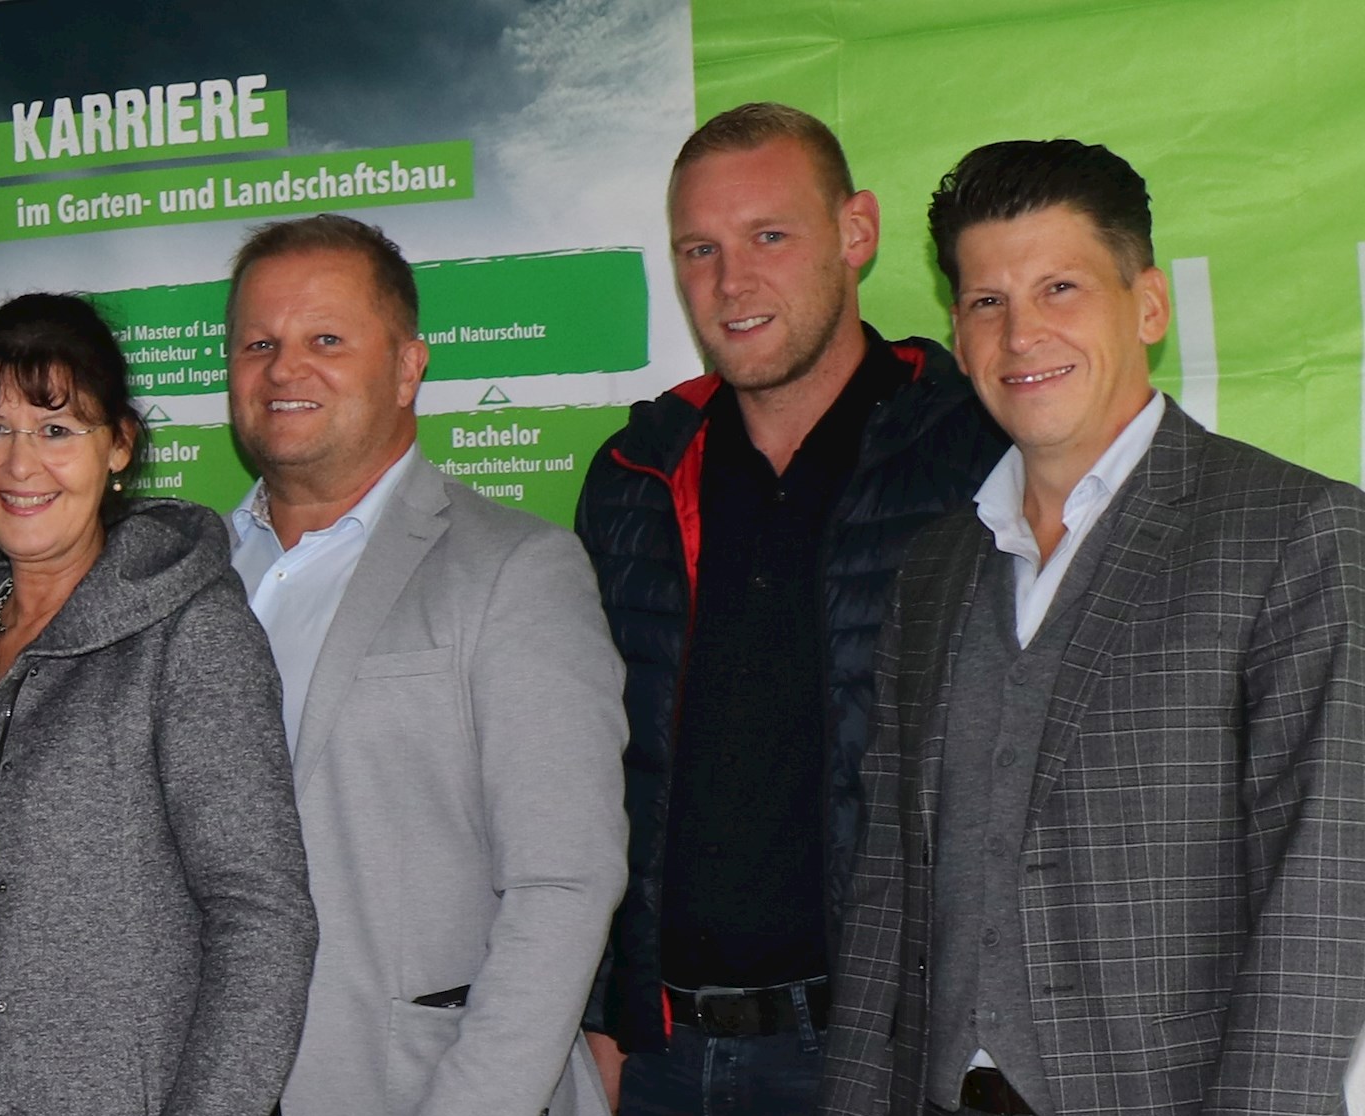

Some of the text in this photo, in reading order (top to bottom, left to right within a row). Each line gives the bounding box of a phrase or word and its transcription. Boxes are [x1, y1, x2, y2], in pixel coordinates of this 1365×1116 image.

[11, 74, 269, 163] KARRIERE
[17, 163, 455, 226] im Garten- und Landschaftsbau.
[135, 325, 181, 341] Master
[185, 320, 199, 337] of
[429, 327, 456, 345] und
[460, 323, 545, 342] Naturschutz
[158, 367, 184, 384] und
[452, 424, 540, 448] Bachelor
[545, 454, 574, 471] und
[155, 471, 182, 488] und
